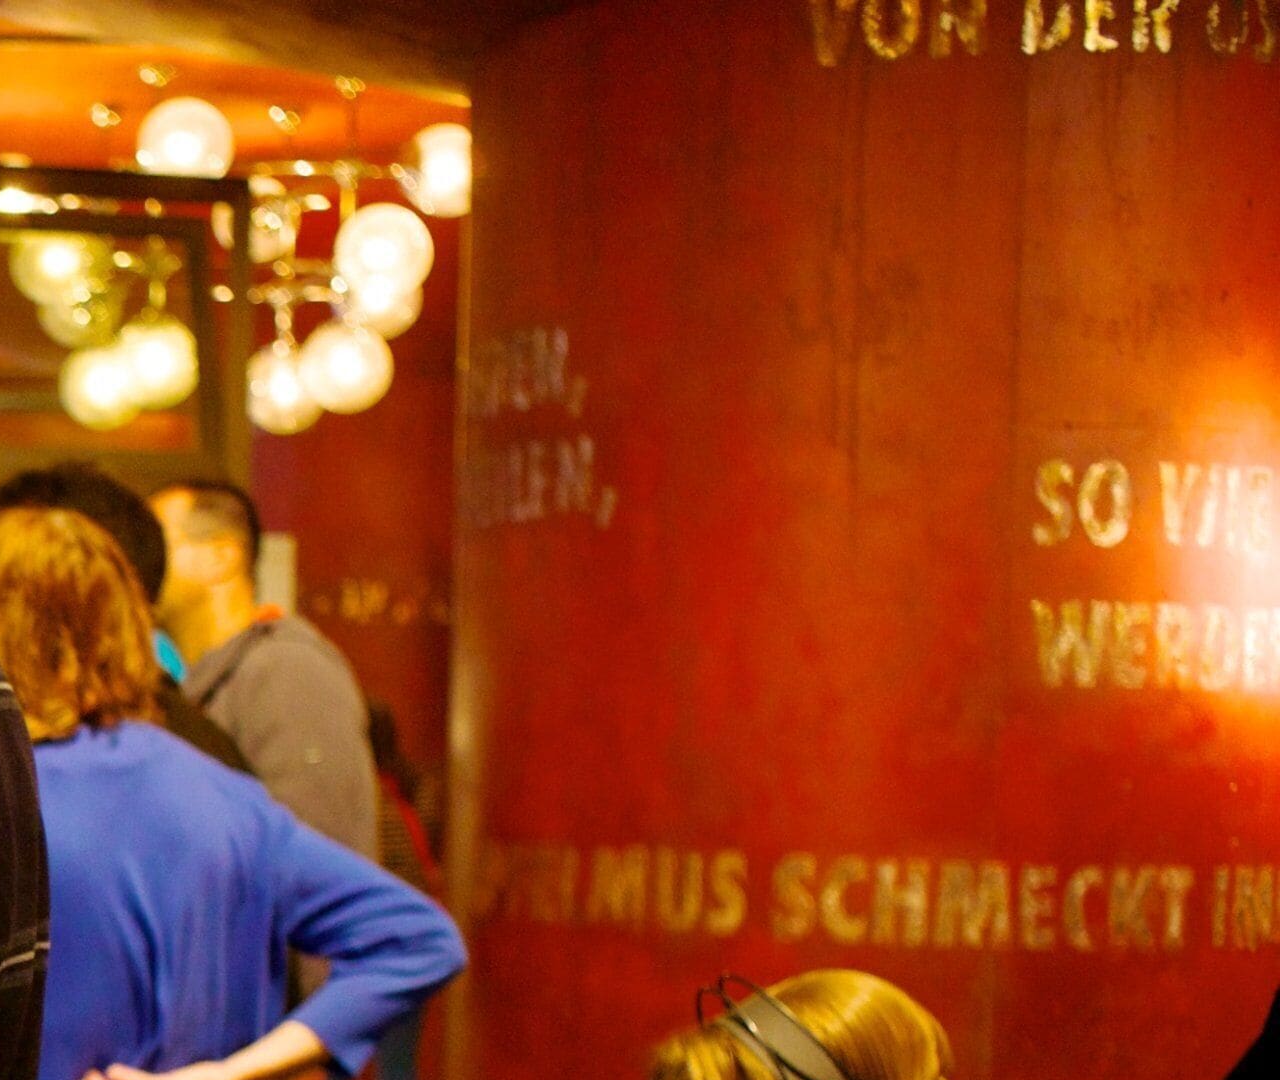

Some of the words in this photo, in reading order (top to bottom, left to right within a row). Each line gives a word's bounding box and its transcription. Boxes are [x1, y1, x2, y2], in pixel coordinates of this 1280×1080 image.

[1032, 459, 1131, 548] SO
[1030, 598, 1280, 692] WERDE
[768, 850, 1194, 952] SCHMECKT
